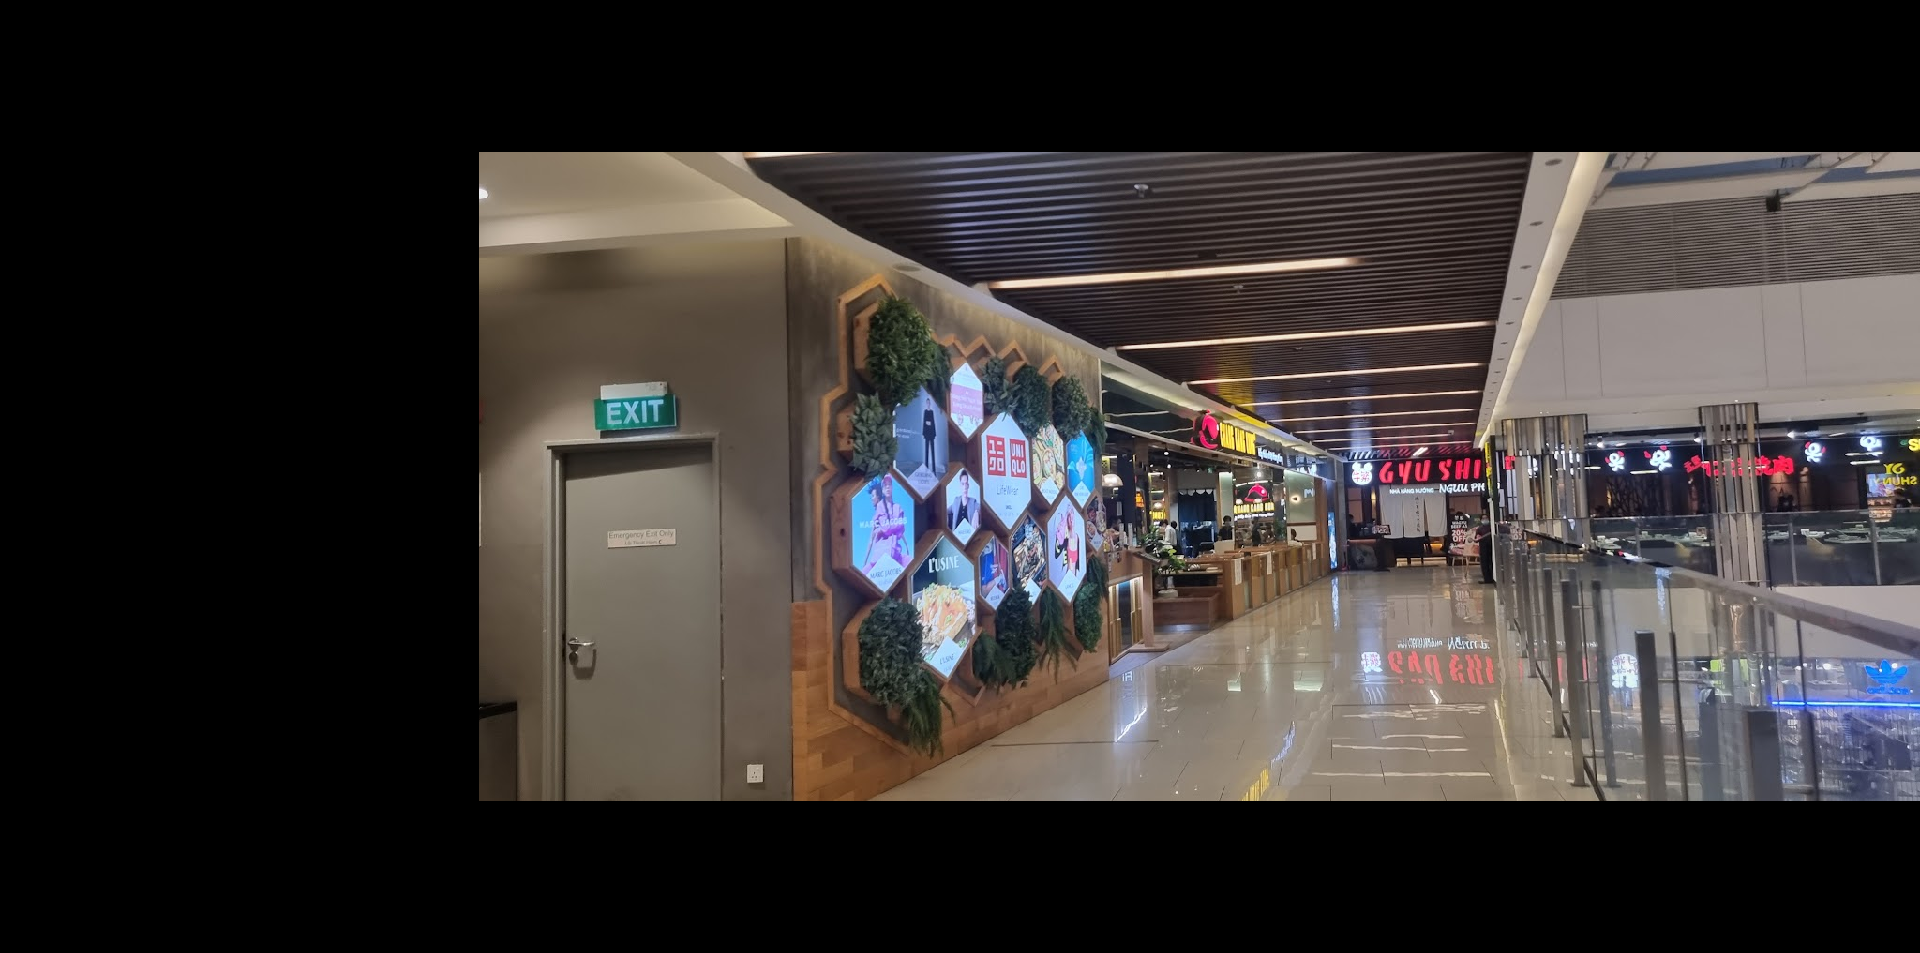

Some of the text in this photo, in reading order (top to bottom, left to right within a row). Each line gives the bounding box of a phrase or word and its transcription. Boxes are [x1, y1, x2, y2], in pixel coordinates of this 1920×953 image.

[606, 399, 664, 425] EXIT
[1011, 443, 1025, 458] UNI
[1011, 459, 1026, 475] QLO
[1378, 458, 1482, 485] GYU SHI
[1470, 482, 1486, 492] PH
[859, 517, 908, 529] MARC JACOBS
[608, 529, 674, 540] Emergency Exit Only
[1451, 529, 1467, 537] 20%
[870, 570, 885, 579] MARC
